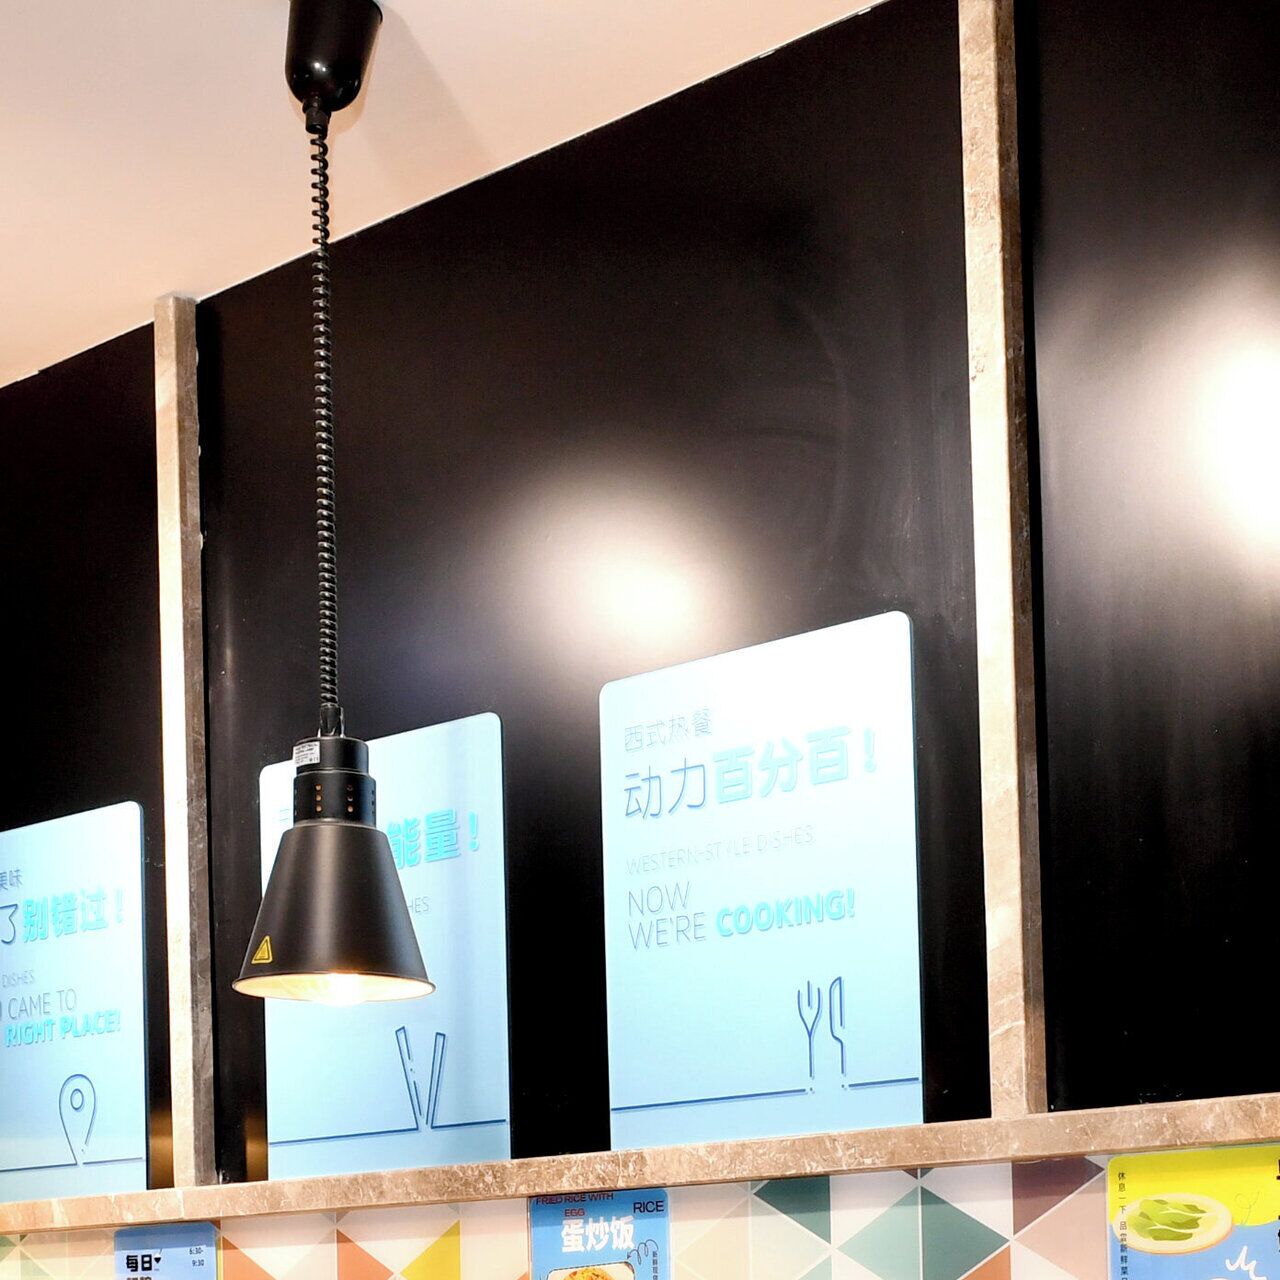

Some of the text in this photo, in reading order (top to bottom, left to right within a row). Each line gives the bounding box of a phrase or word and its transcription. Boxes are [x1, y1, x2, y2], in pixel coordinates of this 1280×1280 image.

[624, 707, 713, 752] 西式热餐
[623, 725, 877, 821] 动力百分百！
[756, 825, 817, 855] DISHES
[627, 882, 692, 919] NOW
[628, 887, 857, 951] WE'RE COOKING!
[2, 969, 35, 988] DISHES
[7, 993, 51, 1020] CAME
[56, 988, 78, 1013] TO
[5, 1018, 56, 1048] RIGHT
[59, 1010, 122, 1040] PLACE!
[536, 1193, 614, 1205] FRIED RICE WITH
[564, 1208, 586, 1217] EGG
[633, 1201, 665, 1214] RICE
[561, 1215, 635, 1253] 蛋炒饭
[126, 1254, 153, 1272] 每日
